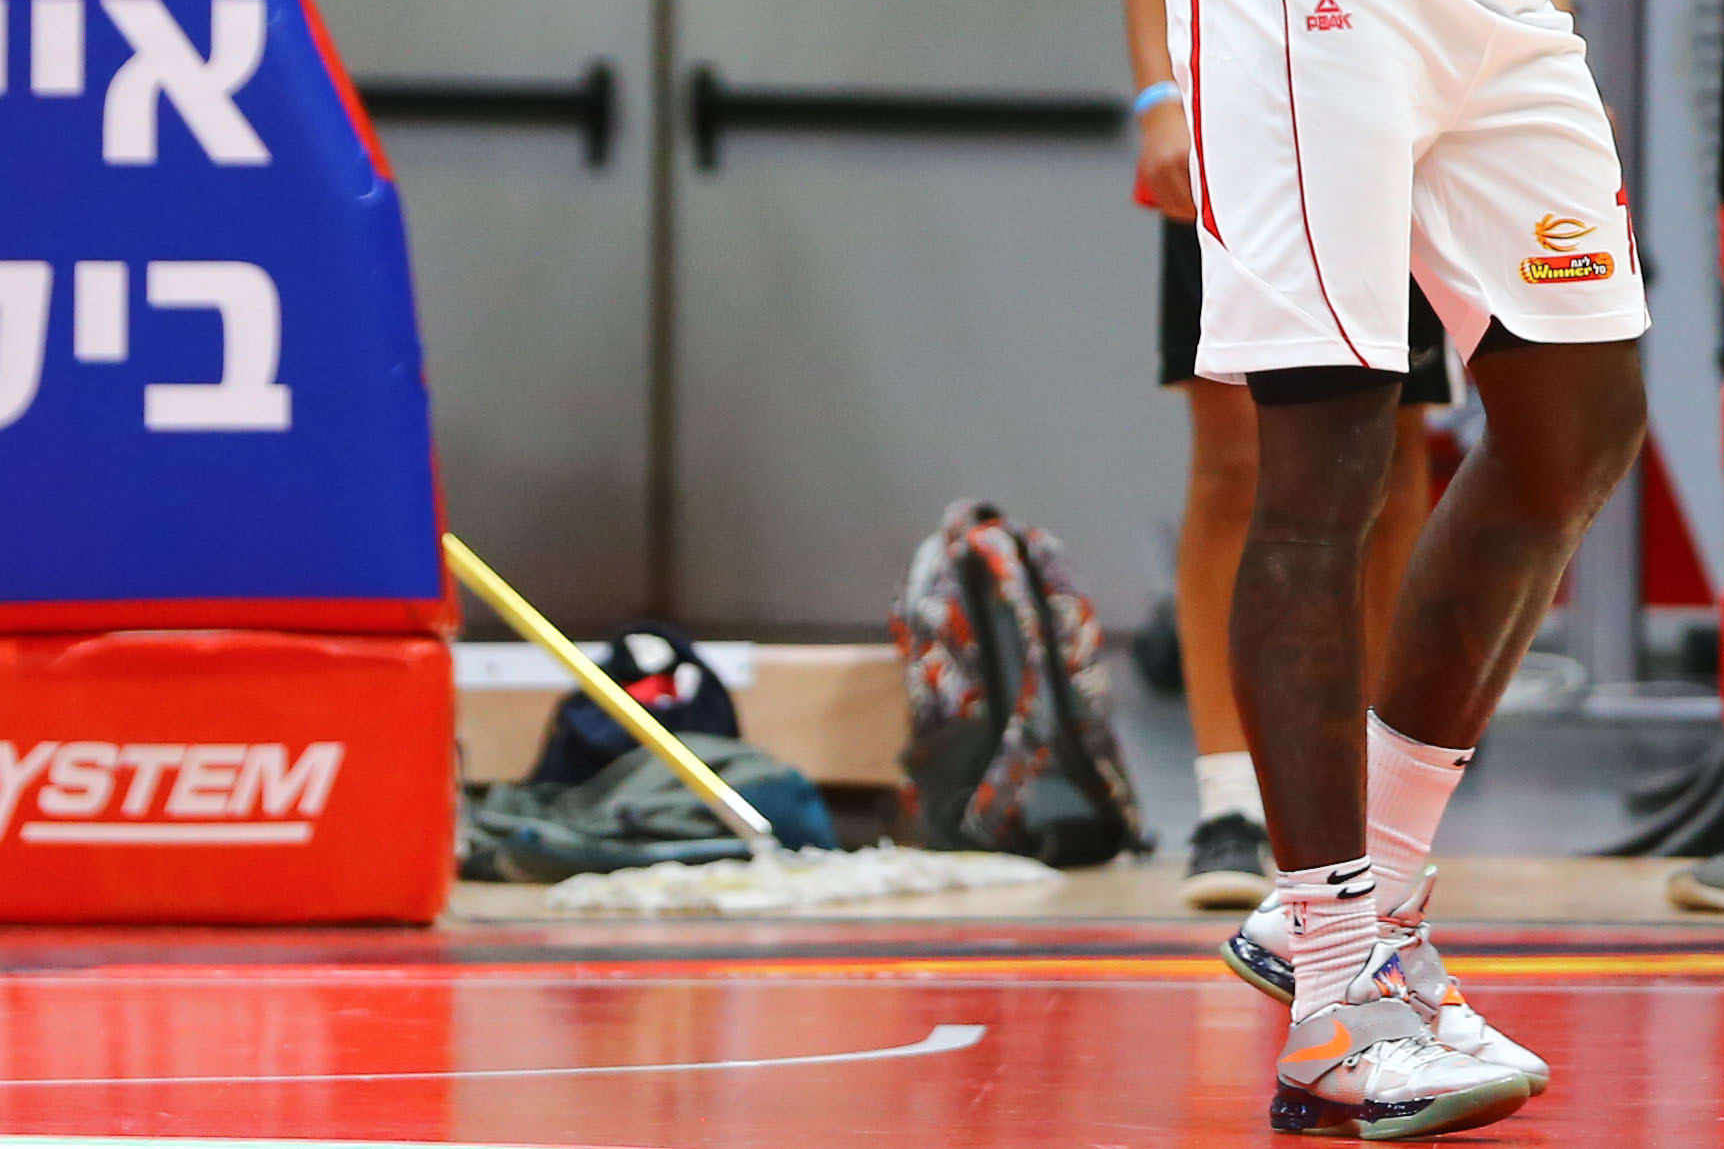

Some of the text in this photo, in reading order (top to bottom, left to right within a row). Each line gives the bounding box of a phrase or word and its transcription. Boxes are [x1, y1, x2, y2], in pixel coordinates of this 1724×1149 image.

[1305, 13, 1353, 31] PEAK
[1530, 264, 1593, 279] Winner
[1592, 263, 1607, 275] סל
